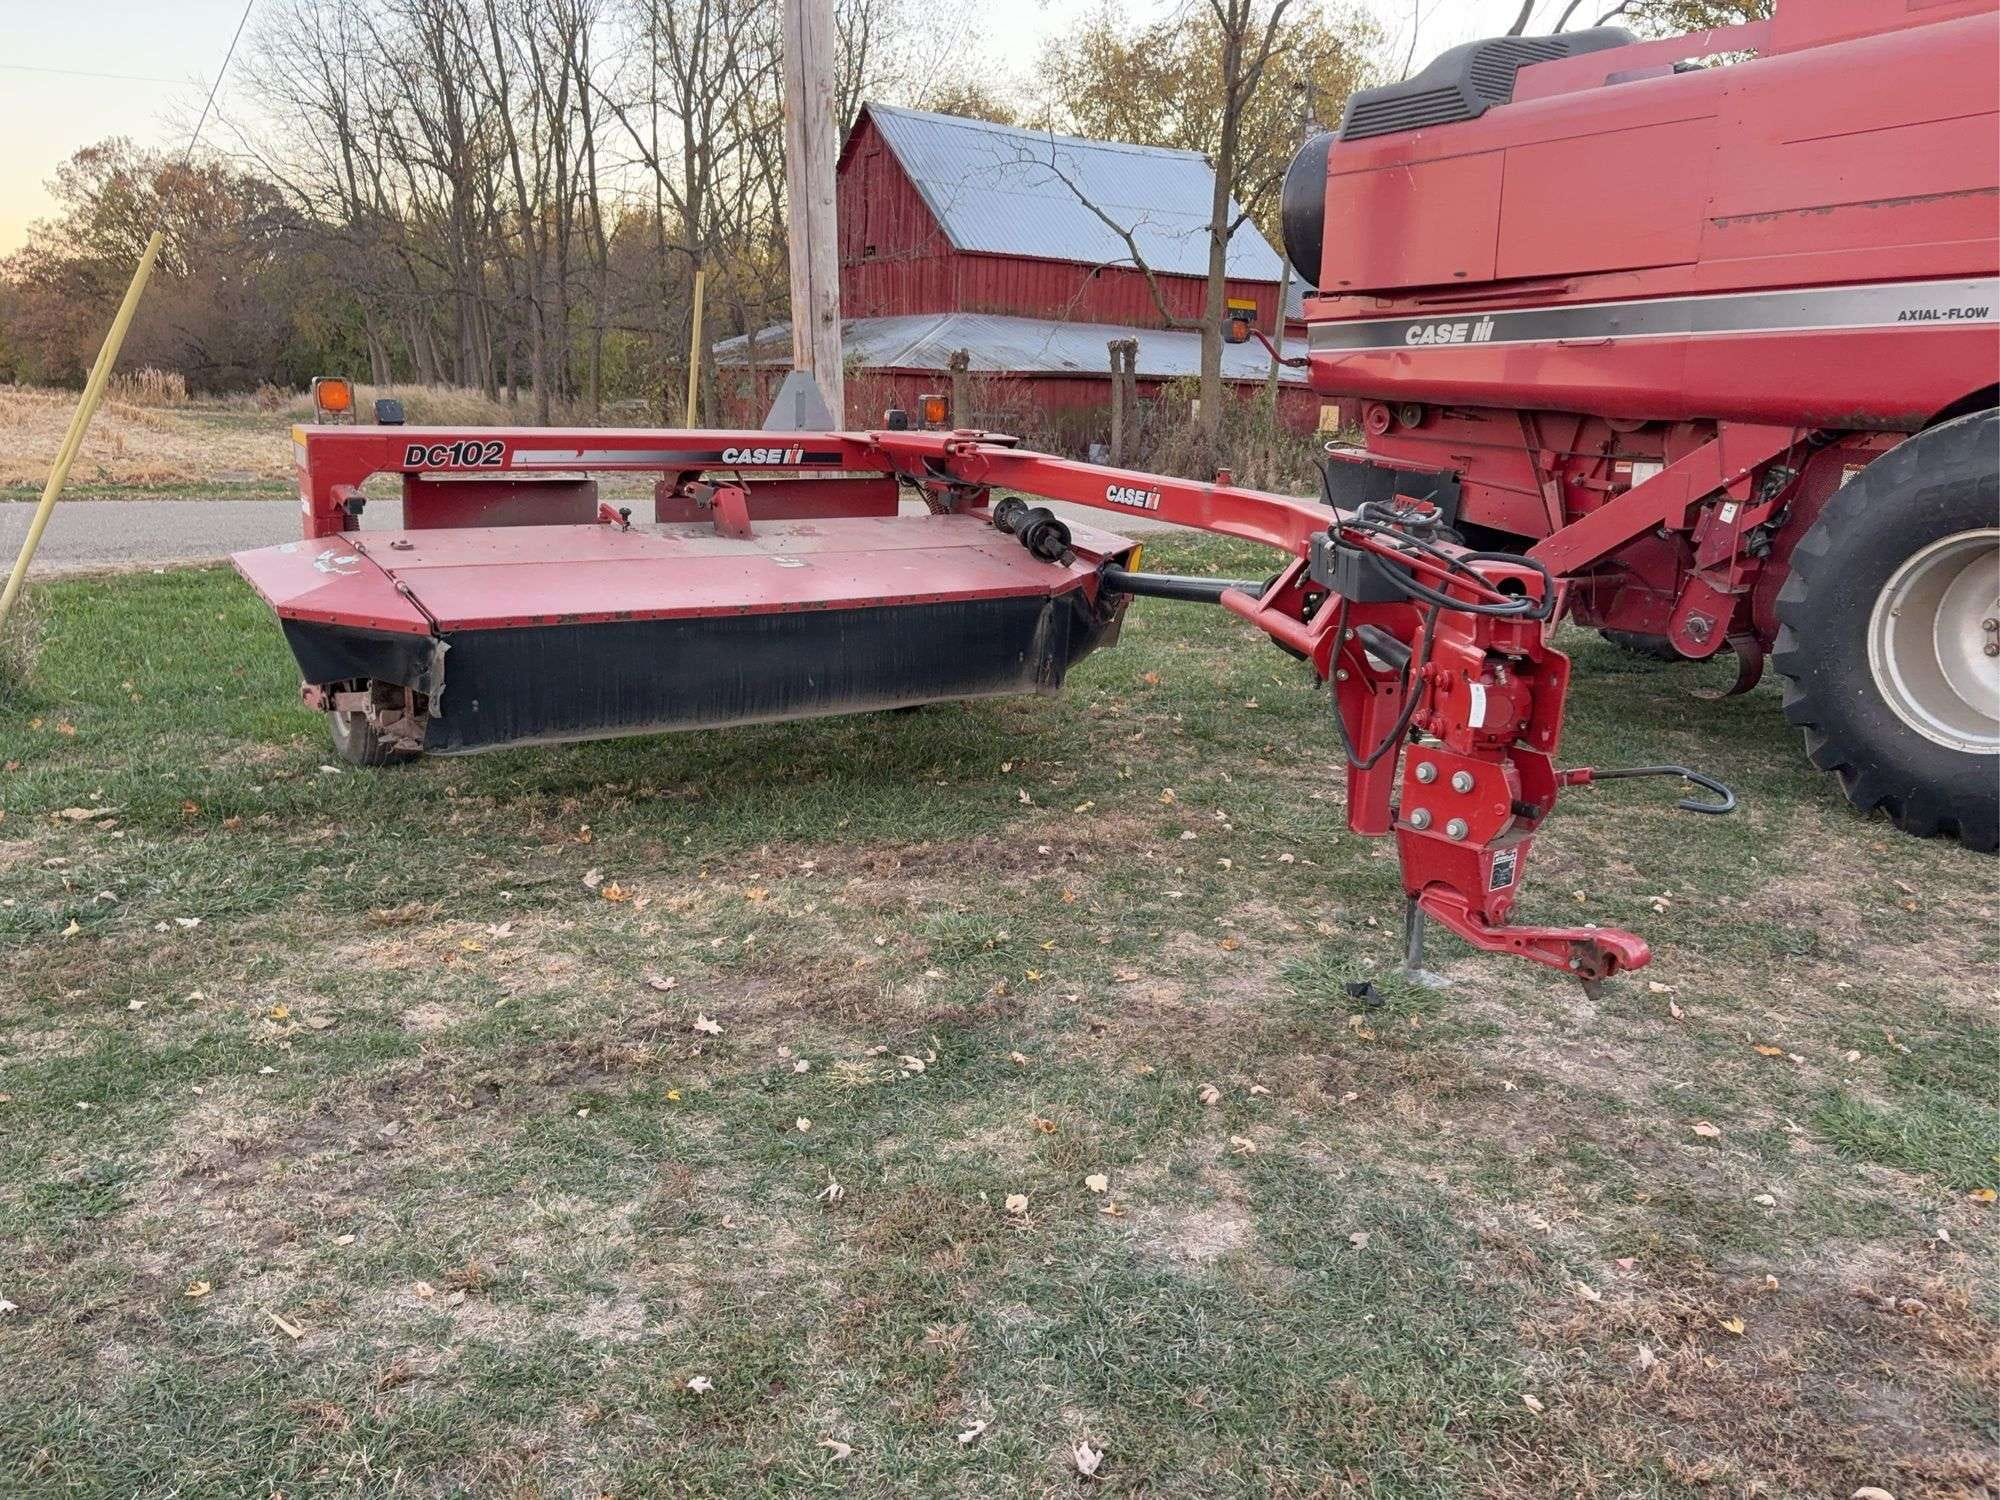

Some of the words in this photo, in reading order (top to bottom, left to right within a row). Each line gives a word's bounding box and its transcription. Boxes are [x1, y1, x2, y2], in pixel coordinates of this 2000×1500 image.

[1897, 307, 1989, 321] AXIAL-FLOW
[1405, 323, 1469, 345] CASE
[403, 440, 506, 467] DC102
[722, 448, 782, 464] CASE
[1106, 485, 1145, 507] CASE
